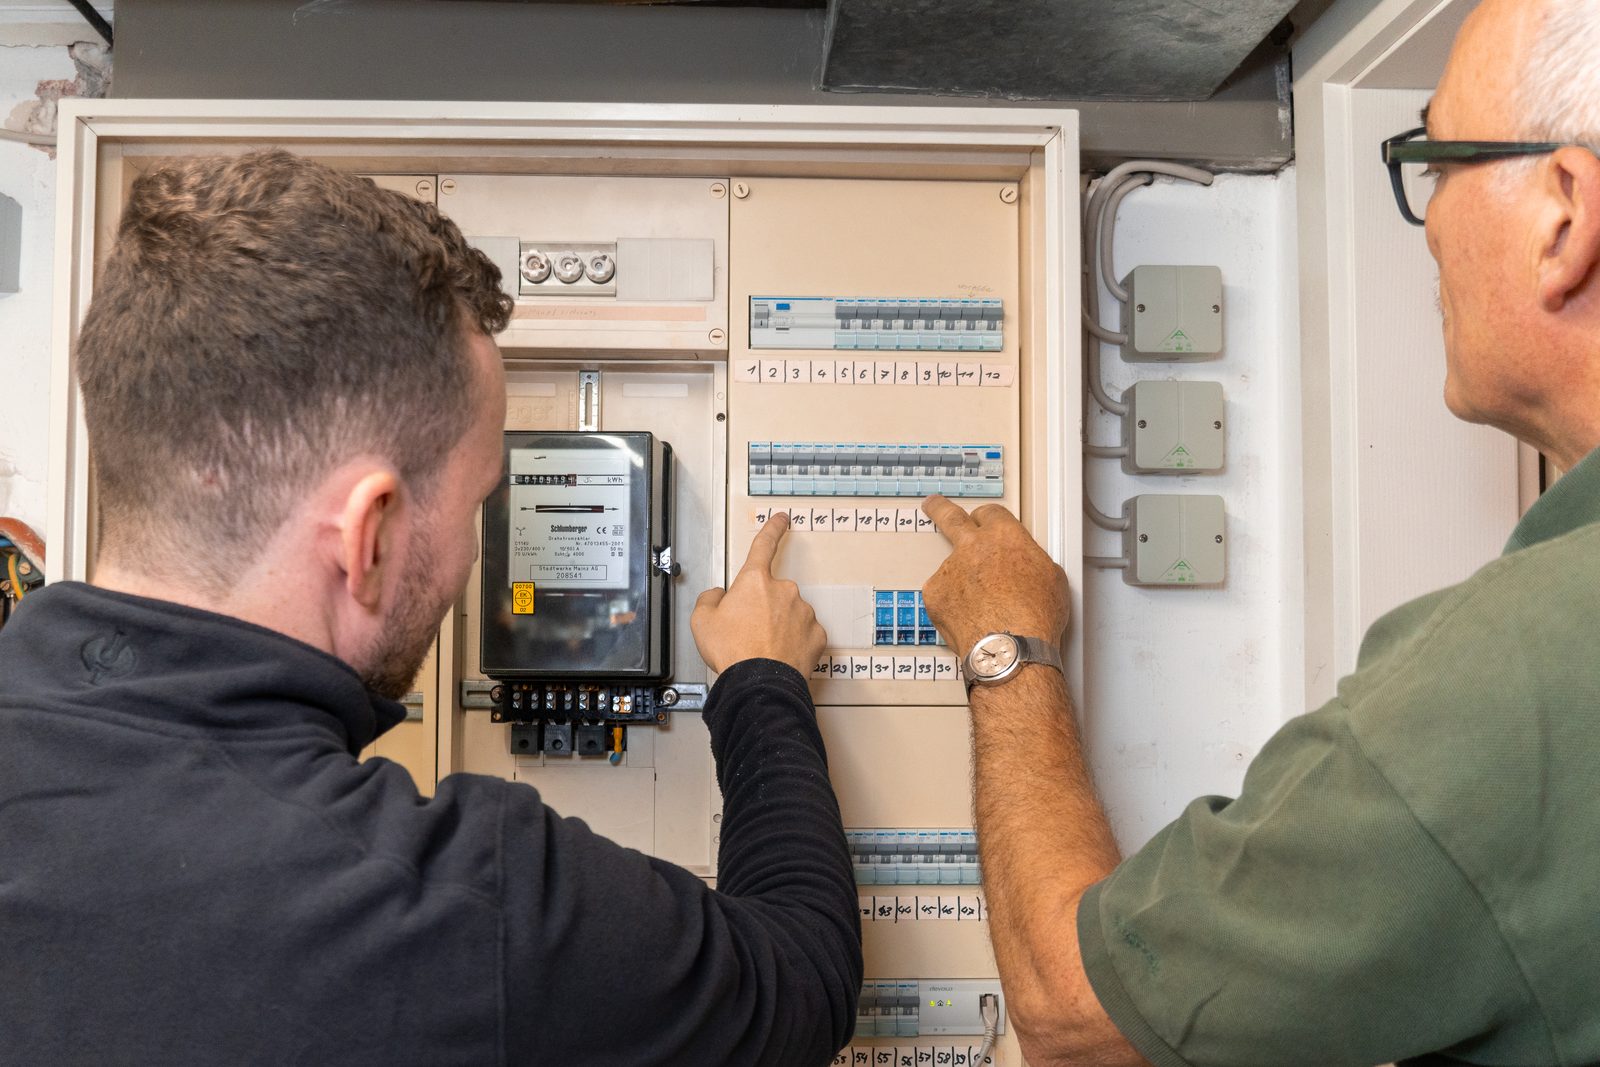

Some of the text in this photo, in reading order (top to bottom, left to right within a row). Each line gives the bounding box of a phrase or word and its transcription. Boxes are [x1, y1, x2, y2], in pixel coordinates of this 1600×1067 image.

[746, 365, 757, 375] 1
[768, 367, 778, 378] 2
[792, 368, 800, 379] 3
[817, 369, 827, 379] 4
[841, 367, 849, 378] 5
[859, 369, 868, 379] 6
[880, 370, 890, 380] 7
[900, 370, 909, 380] 8
[923, 370, 931, 381] 9
[938, 370, 952, 379] 10
[957, 371, 975, 379] 11
[755, 514, 932, 527] 13 15 16 17 18 19 20 21
[550, 524, 588, 534] Schlumberger
[813, 663, 829, 673] 28
[832, 663, 848, 674] 29
[854, 664, 868, 673] 30
[874, 663, 890, 673] 31
[897, 664, 912, 673] 32
[917, 663, 932, 674] 33
[921, 904, 938, 915] 45
[941, 904, 955, 915] 46
[855, 1052, 869, 1064] 54
[876, 1051, 893, 1064] 55
[901, 1055, 913, 1067] 56
[918, 1051, 931, 1062] 57
[936, 1051, 951, 1064] 58
